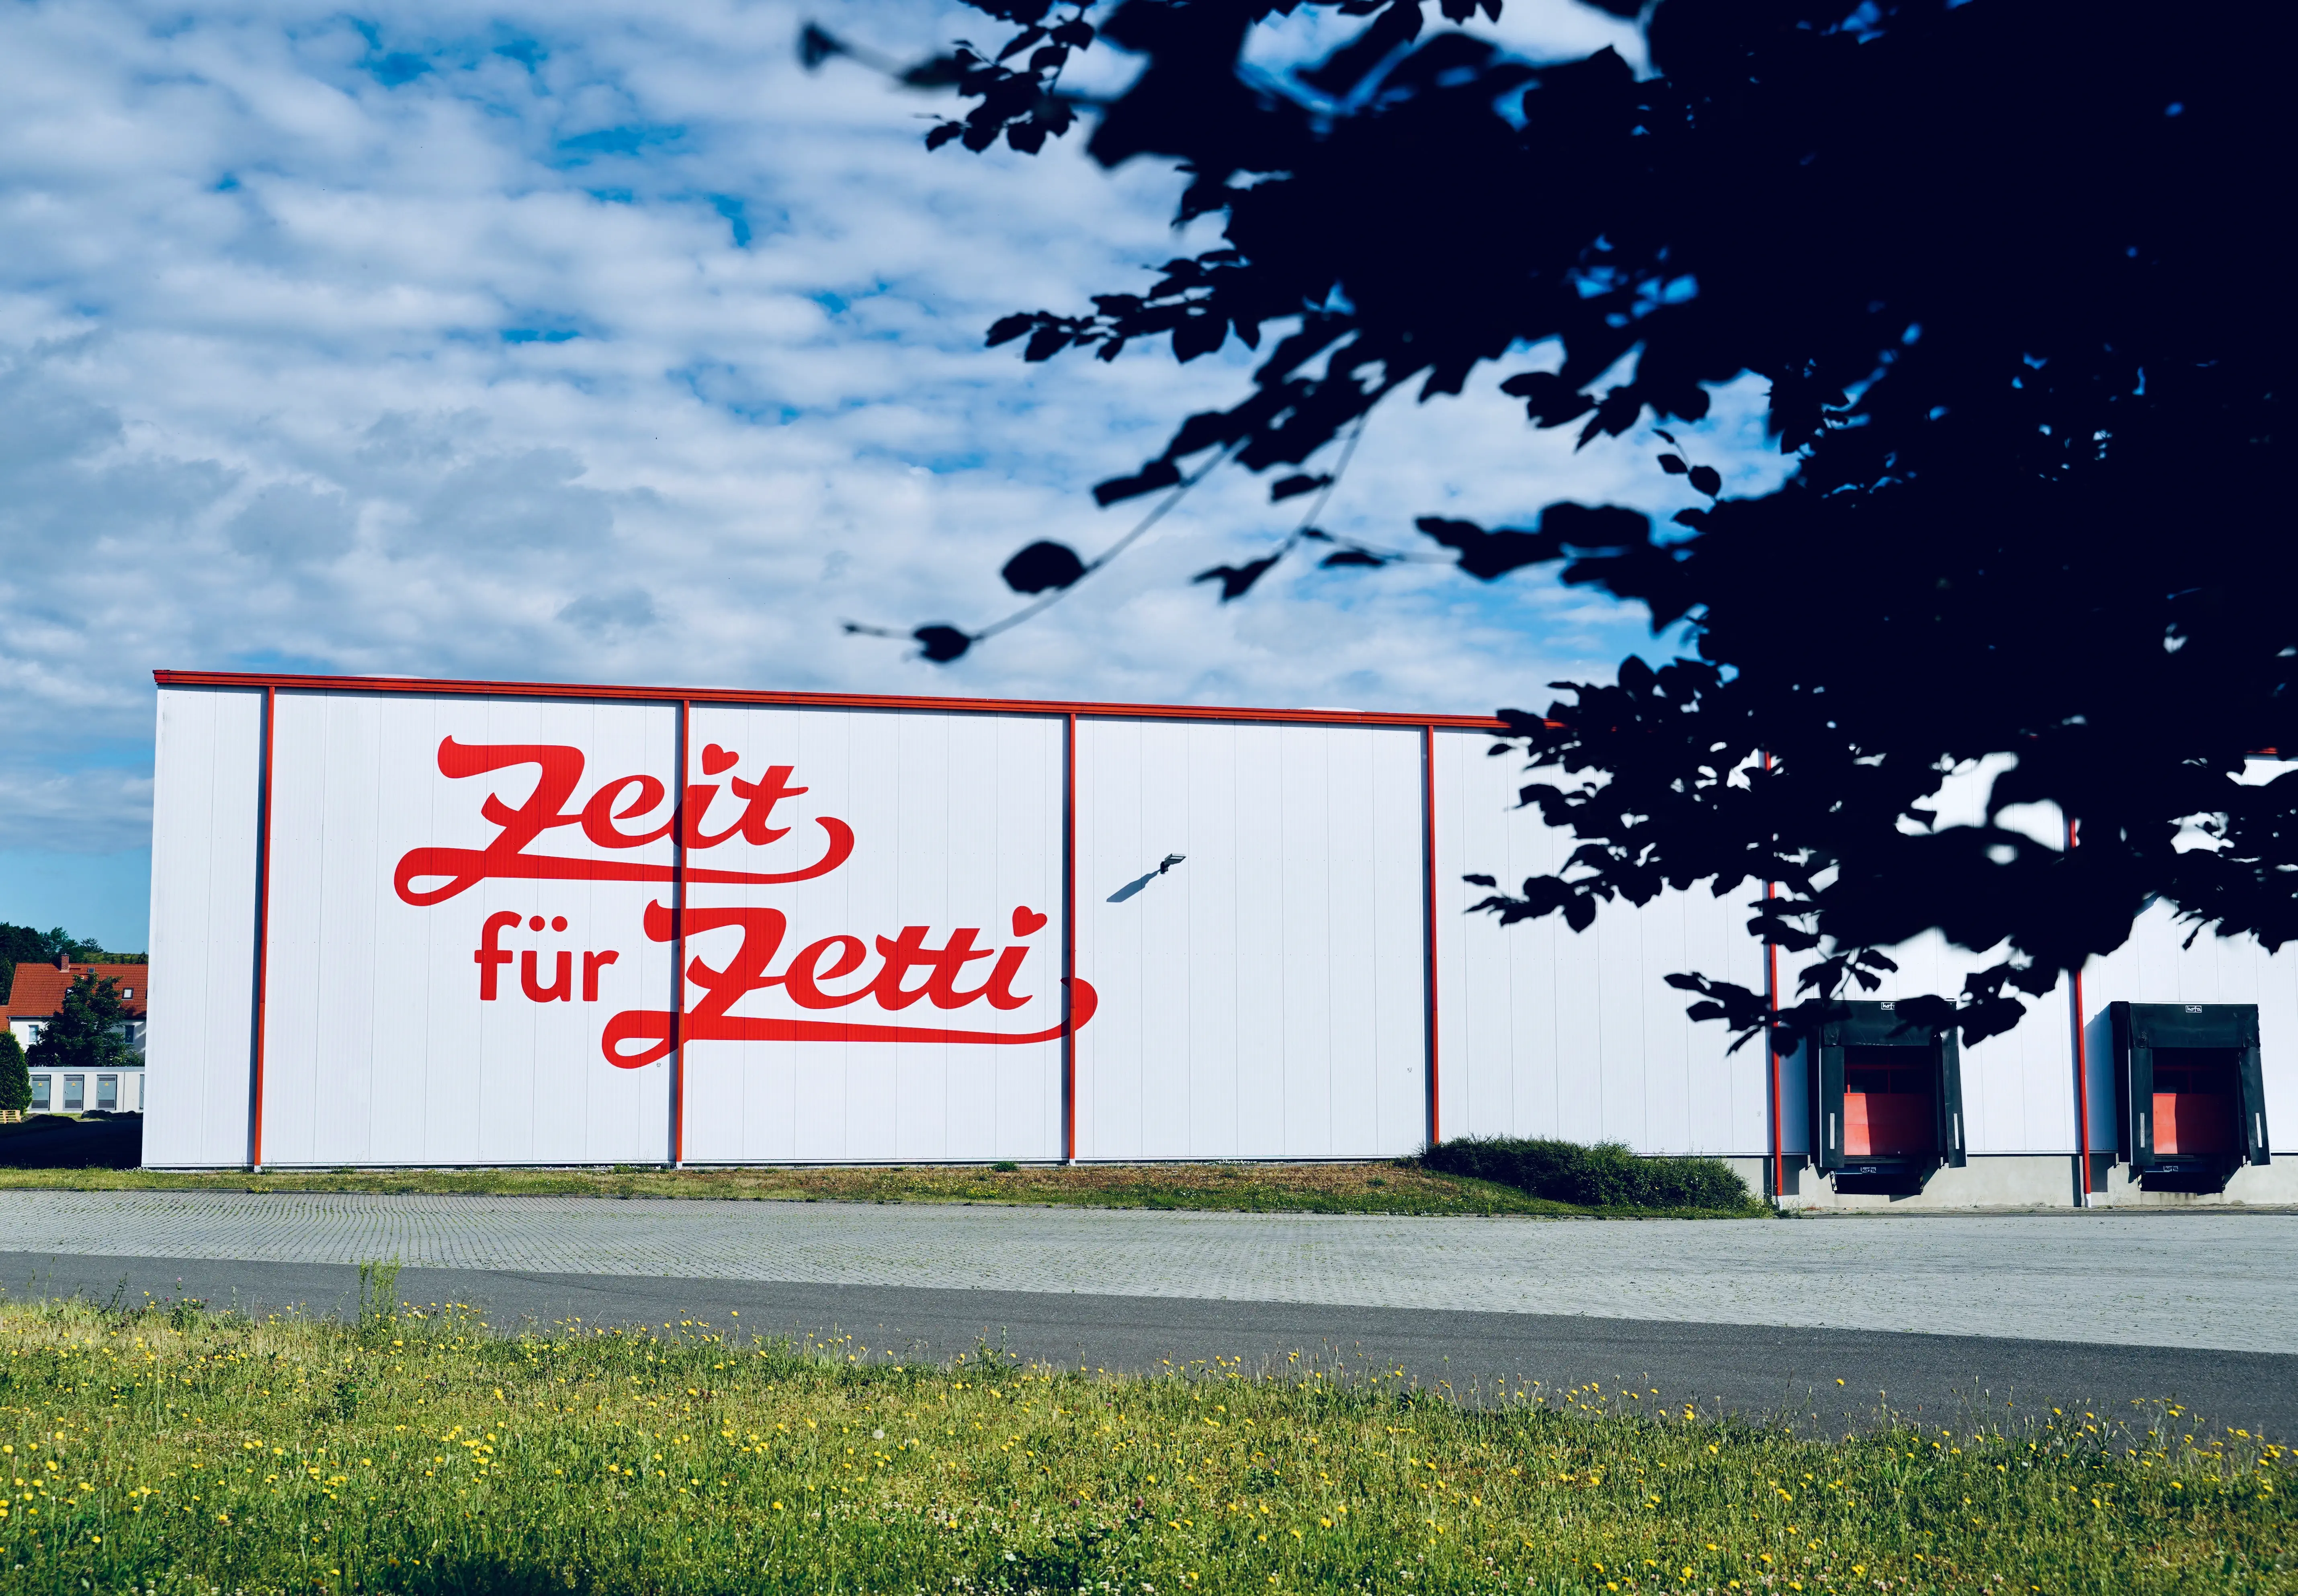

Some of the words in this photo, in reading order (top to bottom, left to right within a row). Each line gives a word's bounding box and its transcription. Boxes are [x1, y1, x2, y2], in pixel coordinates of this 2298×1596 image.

[394, 735, 854, 906] Zeit
[475, 911, 619, 1003] für
[602, 899, 1098, 1069] Zetti
